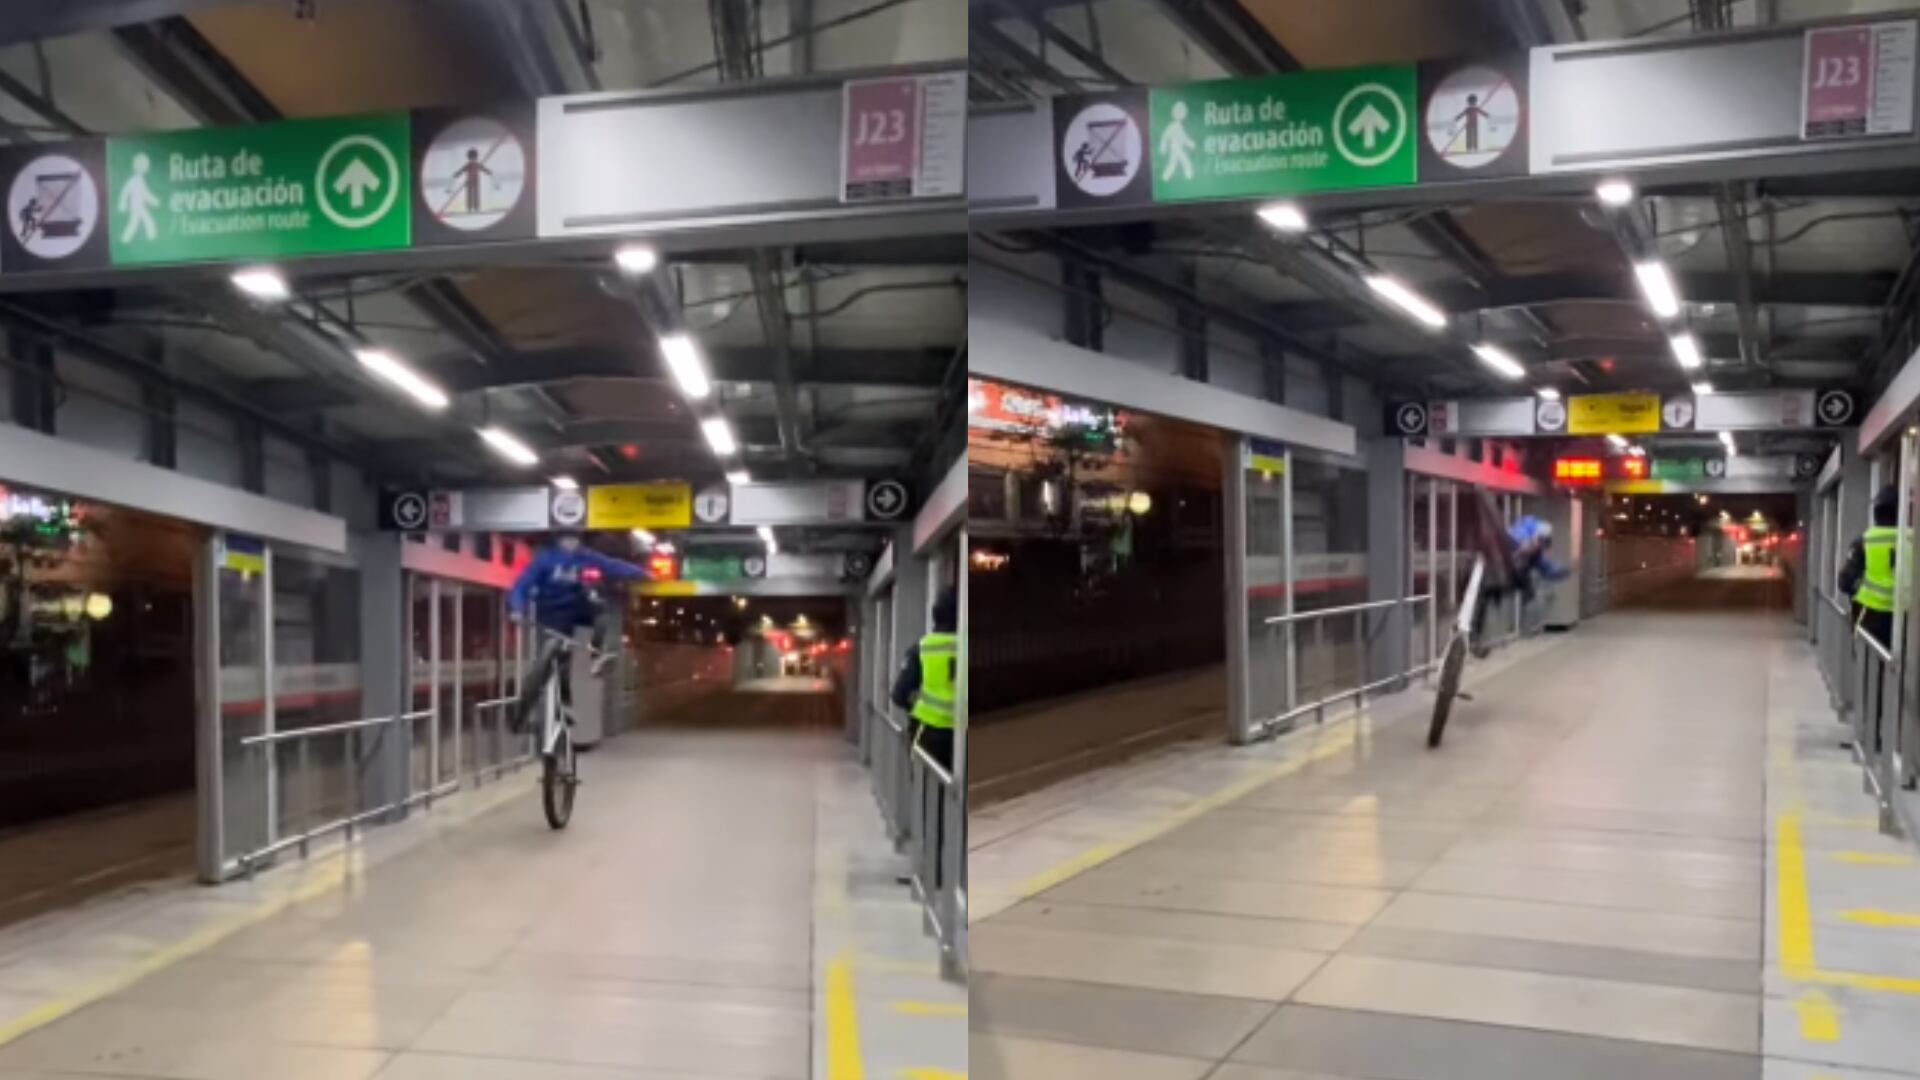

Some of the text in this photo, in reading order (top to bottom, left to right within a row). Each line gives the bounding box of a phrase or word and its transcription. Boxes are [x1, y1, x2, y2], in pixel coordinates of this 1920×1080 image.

[1814, 56, 1860, 88] J23
[854, 109, 905, 145] J23
[1204, 95, 1285, 127] Ruta de
[1204, 121, 1324, 154] evacuación
[169, 147, 263, 180] Ruta de
[170, 177, 304, 213] evacuación
